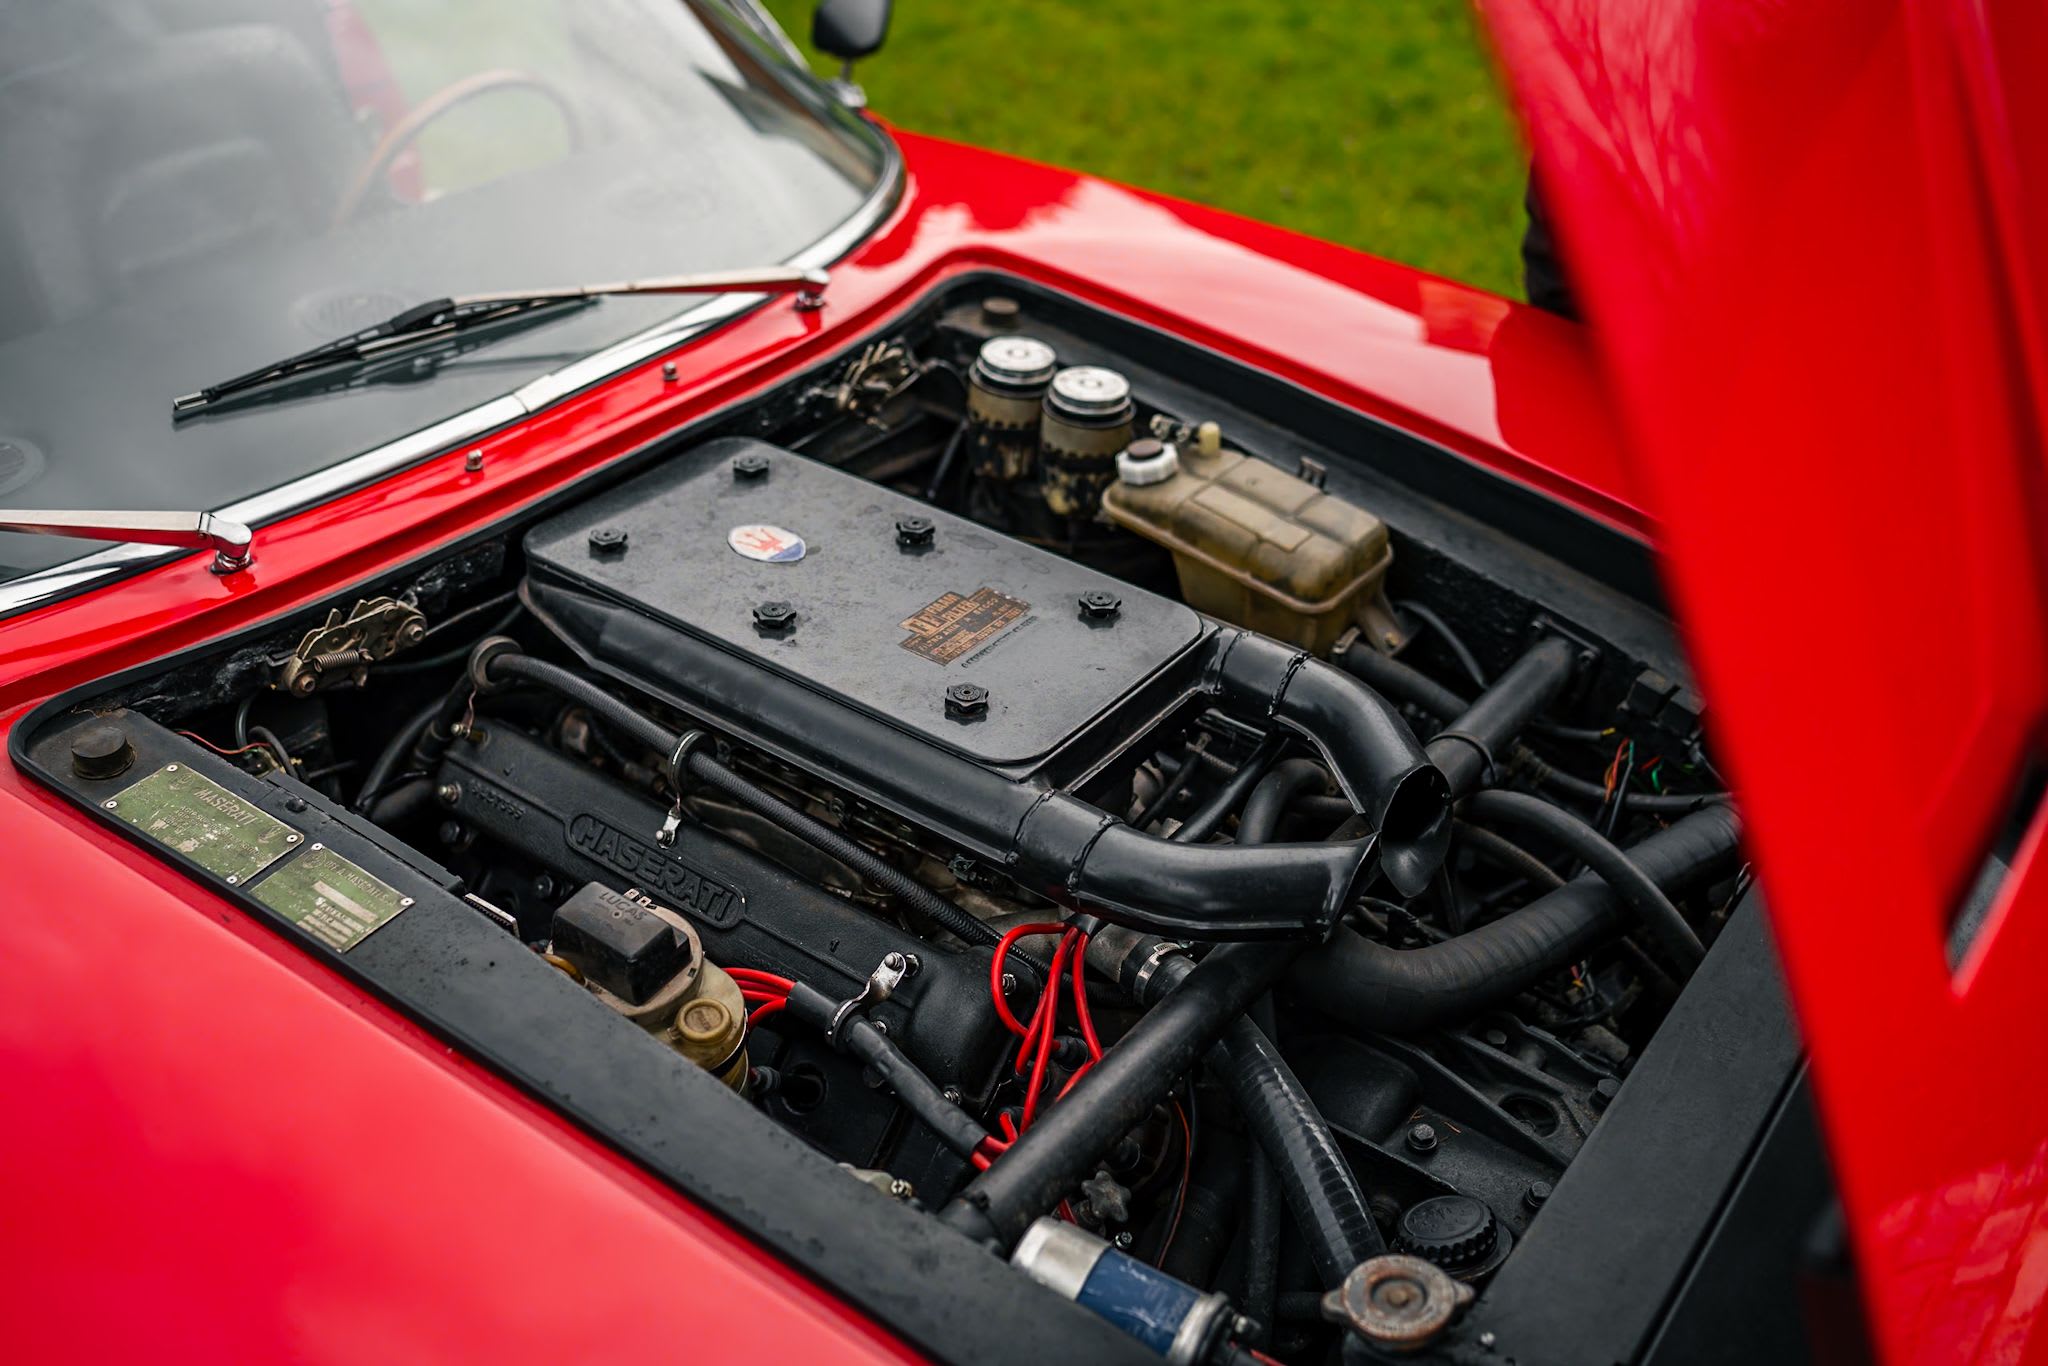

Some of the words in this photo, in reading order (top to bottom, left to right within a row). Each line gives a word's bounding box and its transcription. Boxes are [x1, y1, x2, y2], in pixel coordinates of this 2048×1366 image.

[940, 598, 978, 622] FILTER
[193, 788, 258, 826] MASERATI
[345, 872, 384, 898] MASERATI
[576, 819, 735, 922] MASERATI
[598, 892, 649, 922] LUCAS
